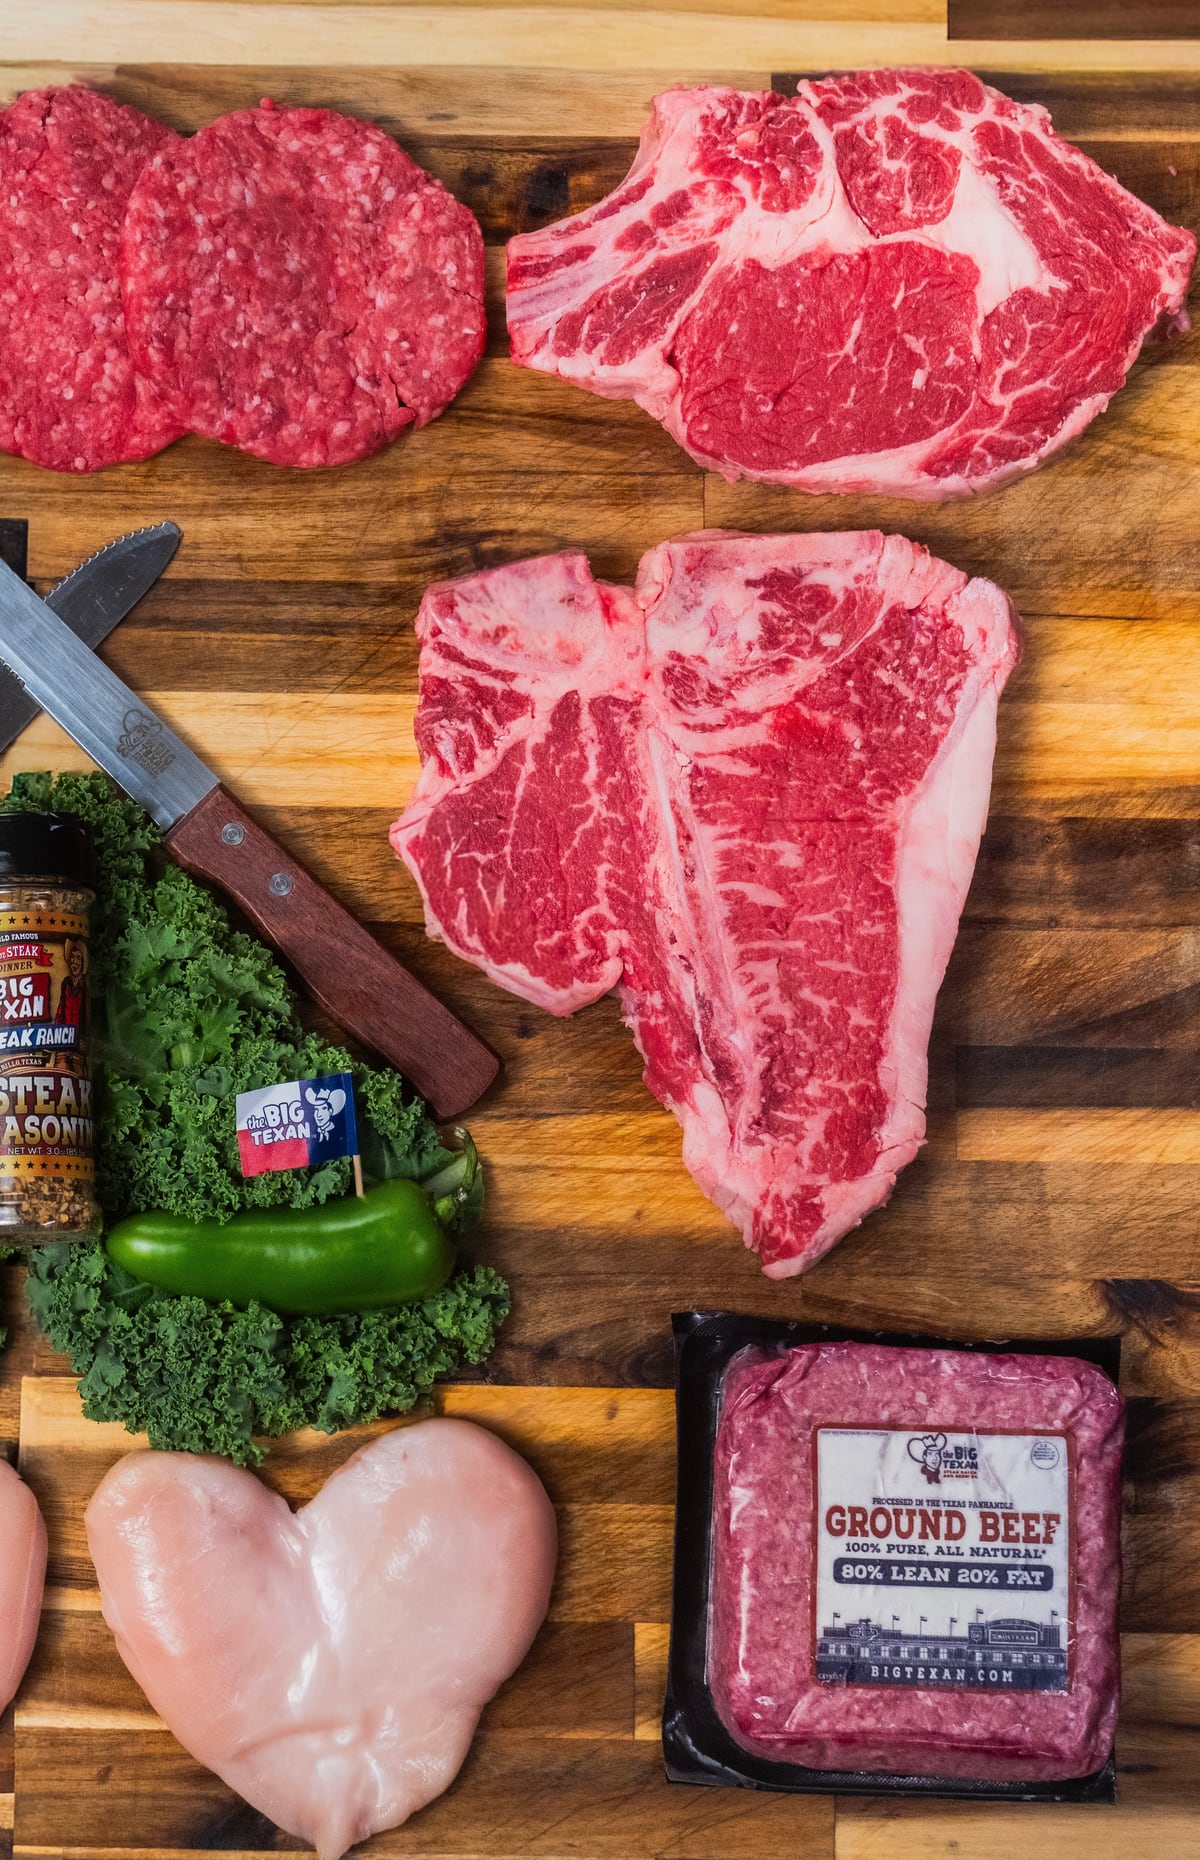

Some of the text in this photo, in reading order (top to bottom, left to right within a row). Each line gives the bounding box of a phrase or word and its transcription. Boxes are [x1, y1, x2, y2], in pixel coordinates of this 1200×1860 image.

[11, 932, 39, 941] FAMOUS
[7, 945, 39, 958] STEAK
[36, 1027, 75, 1046] RANCH
[21, 1058, 42, 1067] TEXAS
[247, 1100, 305, 1130] the BIG
[251, 1123, 311, 1147] TEXAN
[7, 1147, 25, 1155] NET
[943, 1446, 978, 1461] the BIG
[943, 1460, 978, 1470] TEXAN
[872, 1497, 1013, 1510] PROCESSED IN THE TEXAS PANHANDLE
[825, 1505, 1061, 1544] GROUND BEEF
[845, 1543, 881, 1554] 100%
[886, 1543, 929, 1556] PURE,
[934, 1546, 964, 1556] ALL
[842, 1564, 1045, 1585] 80% LEAN 20% FAT
[871, 1665, 1014, 1682] BIGTEXAN.COM
